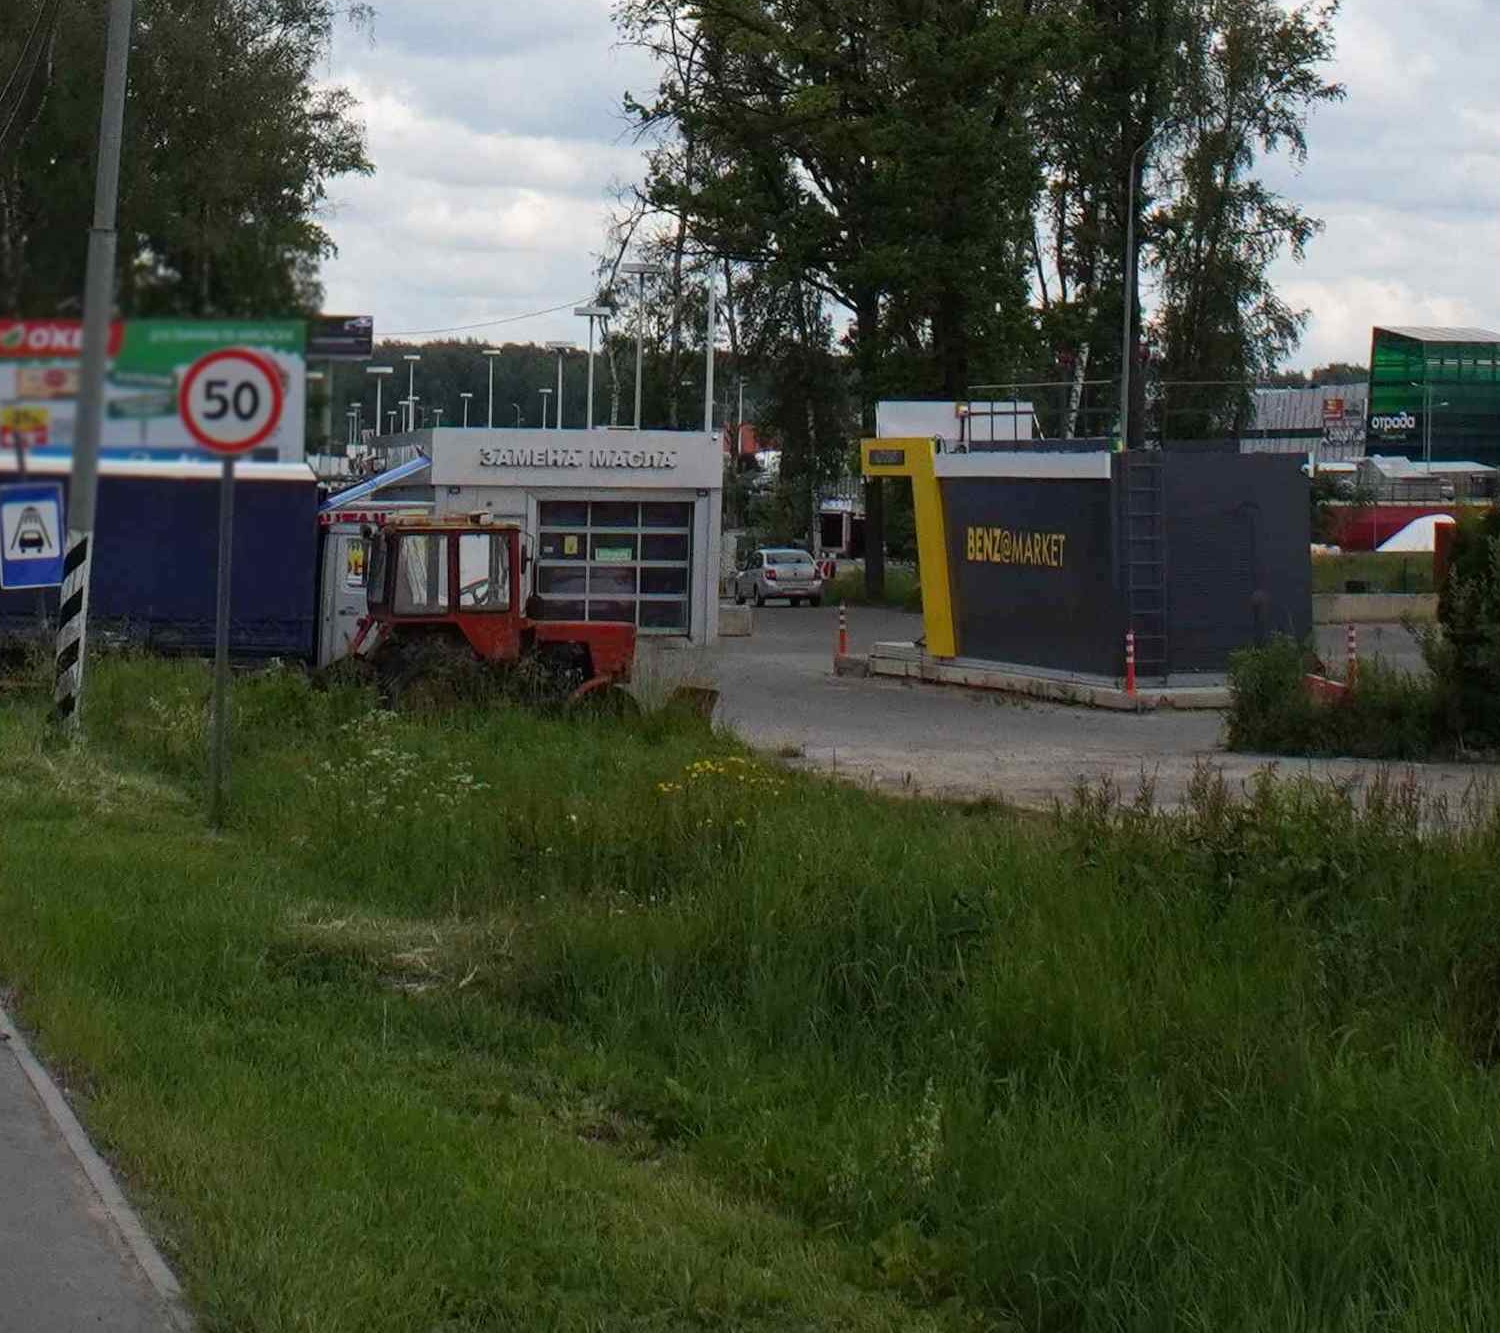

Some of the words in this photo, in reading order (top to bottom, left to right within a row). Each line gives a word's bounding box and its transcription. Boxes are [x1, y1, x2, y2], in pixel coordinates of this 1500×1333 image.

[203, 379, 260, 421] 50
[480, 447, 582, 469] ЗАМЕНА
[590, 449, 677, 470] МАСЛА
[967, 525, 1066, 568] BENZ@MARKET
